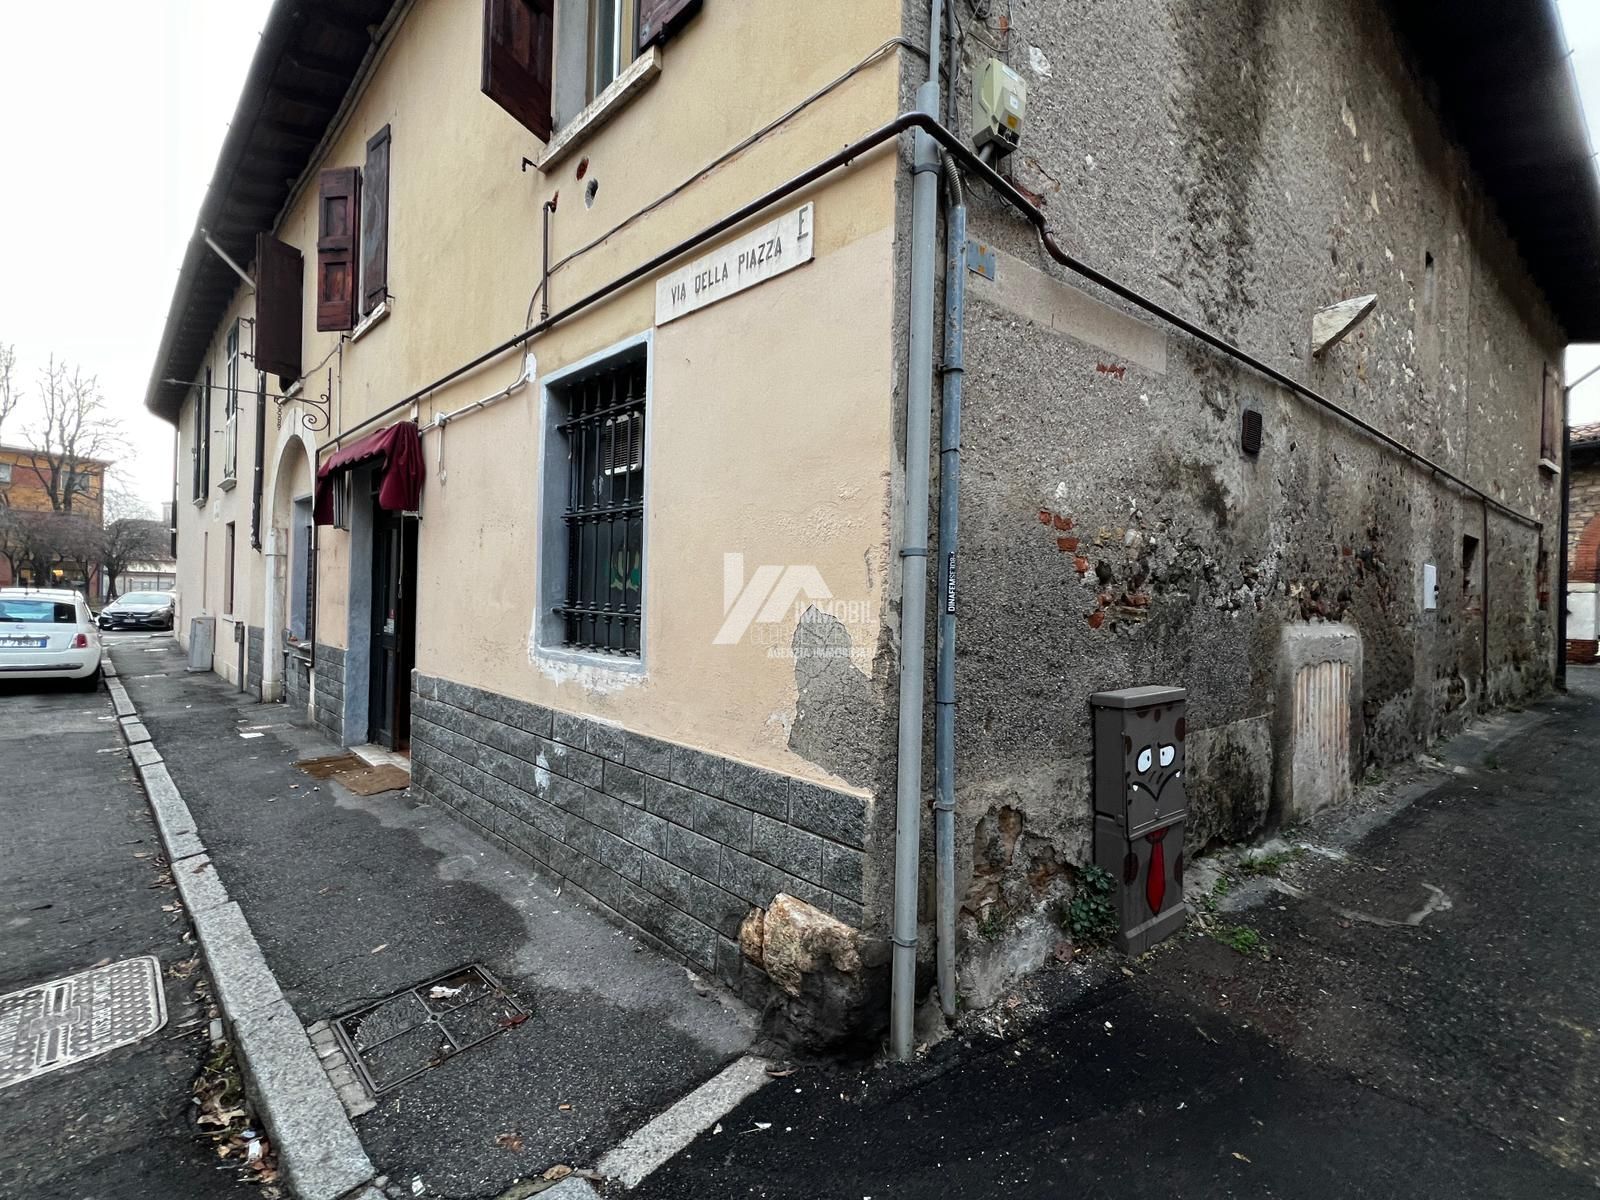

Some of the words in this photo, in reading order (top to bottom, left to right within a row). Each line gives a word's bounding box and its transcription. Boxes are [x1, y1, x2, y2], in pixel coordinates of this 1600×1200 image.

[671, 283, 686, 305] VIA
[694, 262, 728, 294] DELLA
[738, 237, 783, 274] PIAZZA
